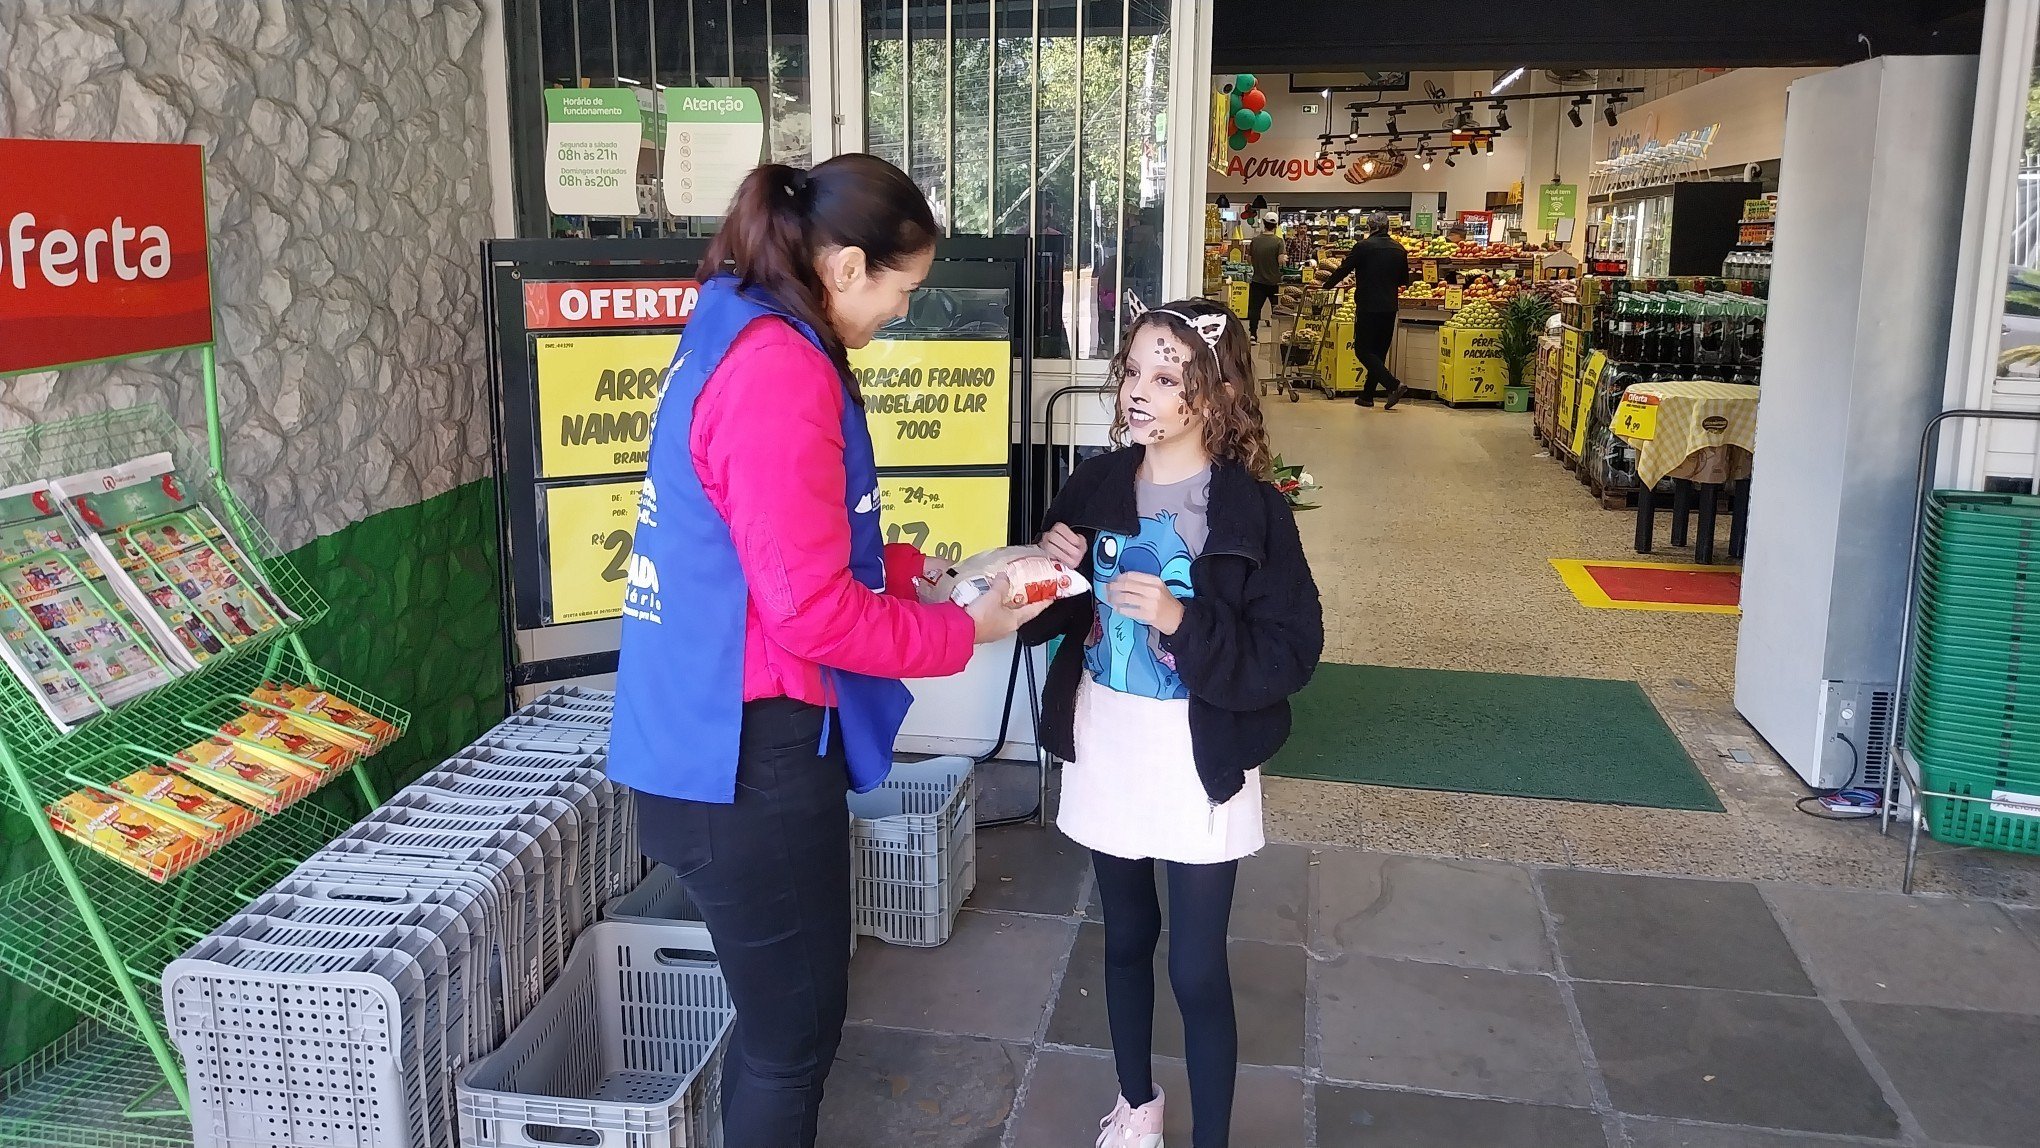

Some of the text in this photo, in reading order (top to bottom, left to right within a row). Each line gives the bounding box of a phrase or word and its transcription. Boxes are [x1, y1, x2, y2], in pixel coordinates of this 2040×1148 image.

[563, 97, 603, 106] Horário de
[682, 95, 744, 116] Atenção
[563, 107, 623, 115] funcionamento
[559, 142, 588, 150] Segunda
[558, 148, 618, 161] 08h às 21h
[1226, 155, 1335, 185] Açougue
[559, 175, 582, 187] 08h
[596, 176, 619, 188] 20h
[0, 212, 171, 289] ferta
[853, 367, 995, 388] ORACAO FRANGO
[865, 393, 988, 414] ONGELADO LAR
[1628, 393, 1648, 403] Oferta
[896, 420, 942, 440] 700G
[612, 508, 628, 517] POR:
[591, 532, 605, 546] R$
